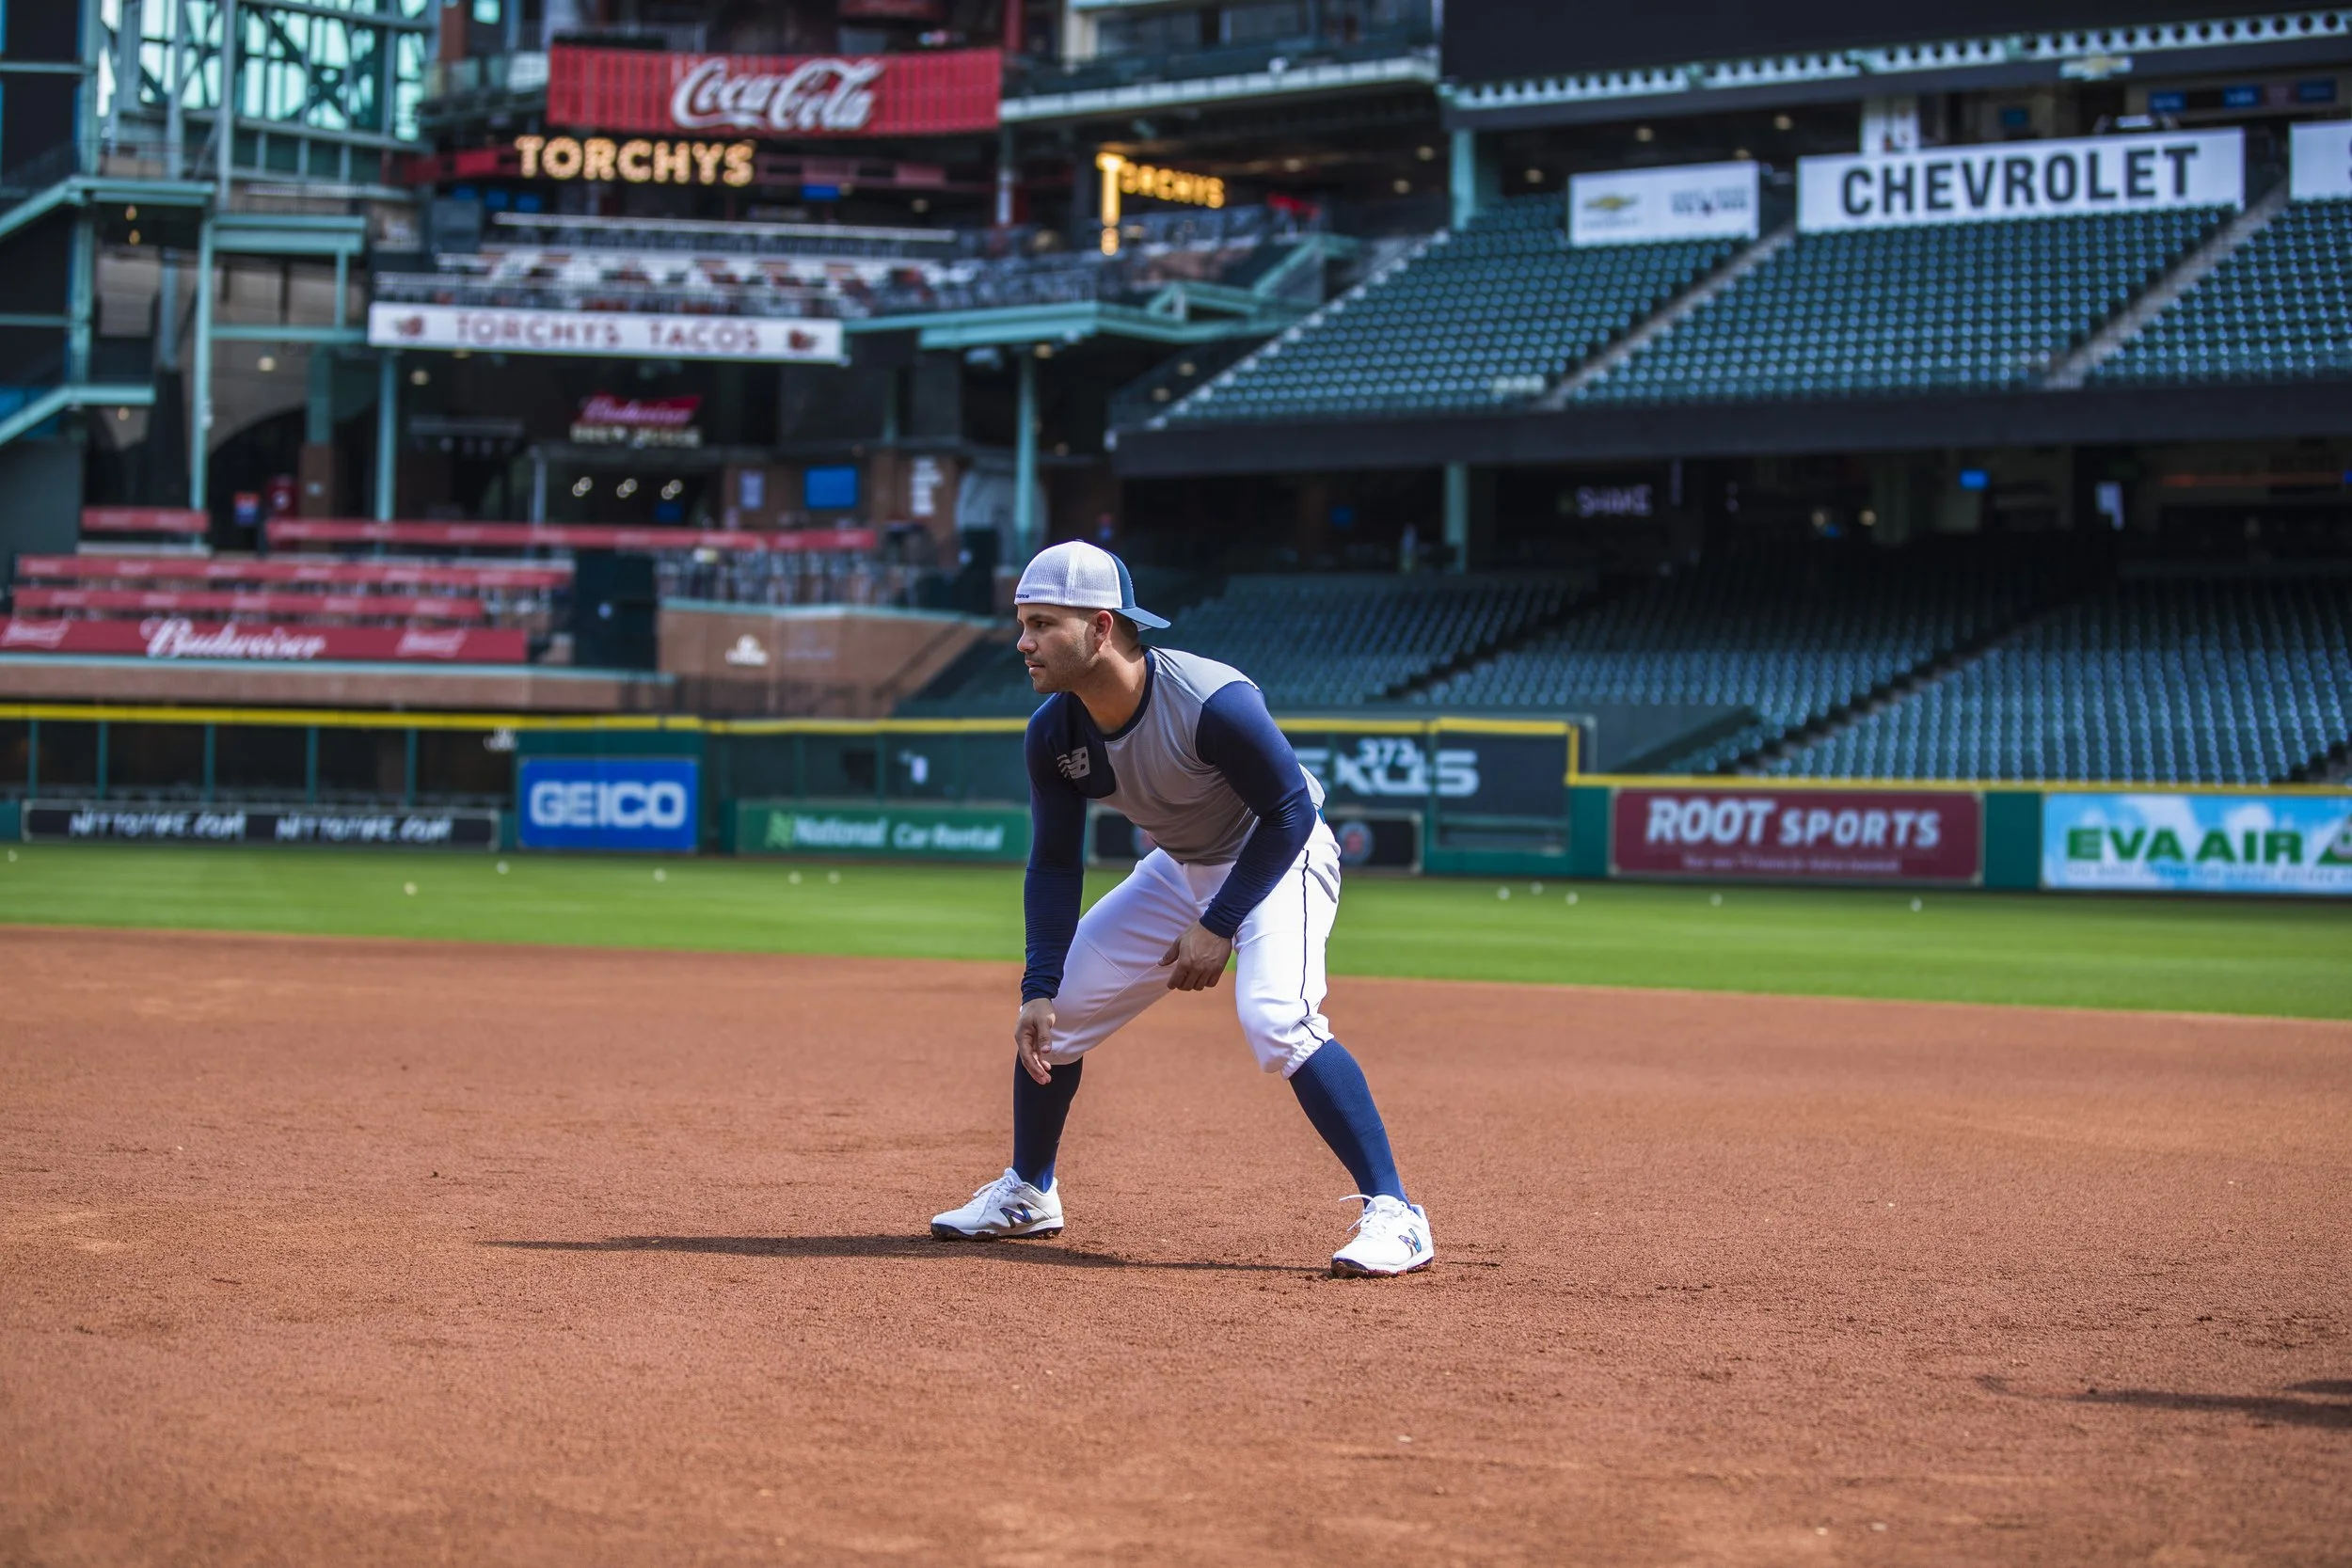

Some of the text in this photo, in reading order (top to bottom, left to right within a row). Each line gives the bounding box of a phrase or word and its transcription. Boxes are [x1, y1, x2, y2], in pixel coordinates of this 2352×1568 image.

[515, 135, 755, 187] TORCHYS
[1841, 144, 2199, 217] CHEVROLET
[457, 313, 759, 351] TORCHYS TACOS
[140, 619, 325, 658] Budweiser
[530, 781, 687, 829] GEICO
[1647, 798, 1941, 847] ROOT SPORTS
[793, 814, 1004, 849] National Car Rental
[2067, 828, 2304, 865] EVA AIR
